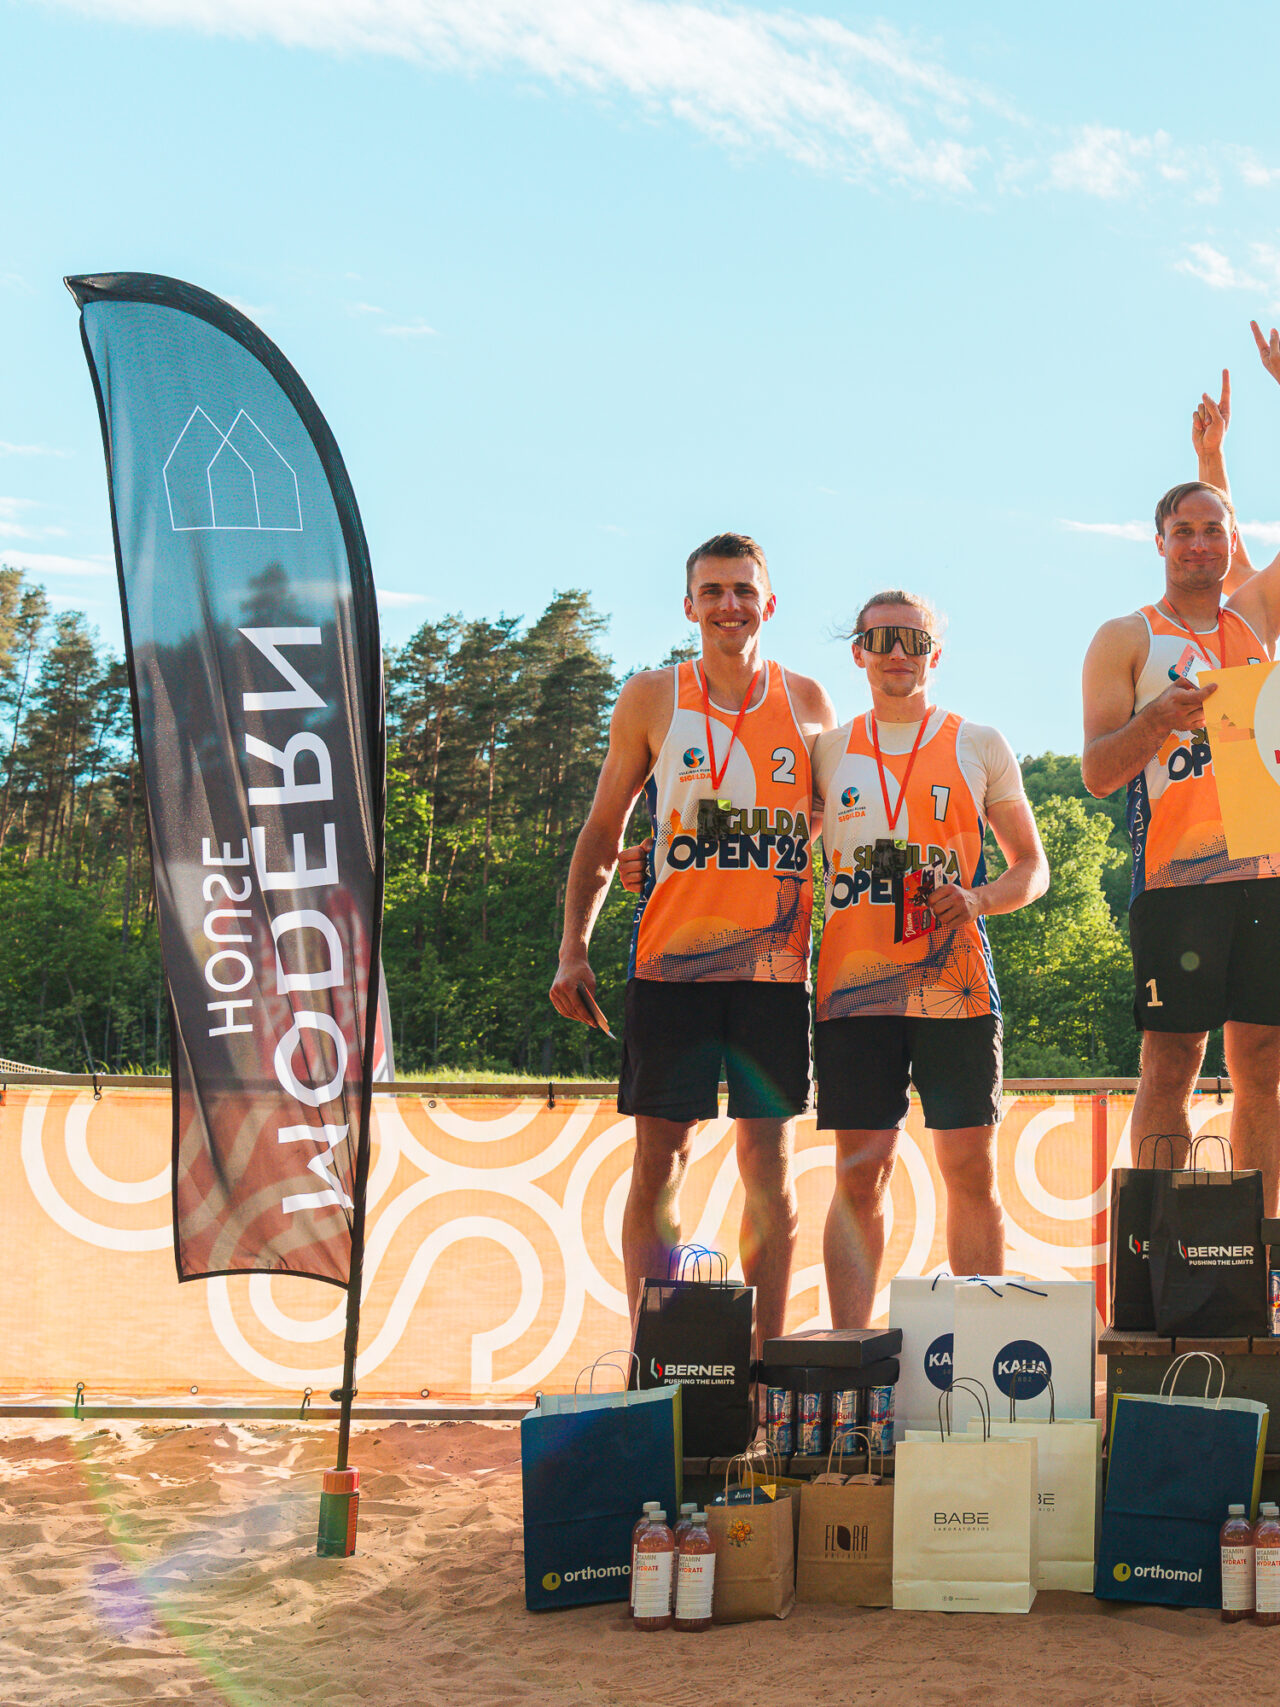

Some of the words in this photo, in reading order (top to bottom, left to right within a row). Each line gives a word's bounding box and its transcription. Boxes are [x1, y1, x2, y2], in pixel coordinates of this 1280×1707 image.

[771, 747, 796, 784] 2
[931, 785, 950, 822] 1
[724, 808, 809, 841] GULDA
[1146, 978, 1163, 1007] 1
[1187, 1246, 1254, 1257] BERNER
[664, 1365, 735, 1376] BERNER
[997, 1359, 1048, 1375] KAIJA
[564, 1564, 631, 1583] orthomo
[1134, 1564, 1202, 1583] orthomol
